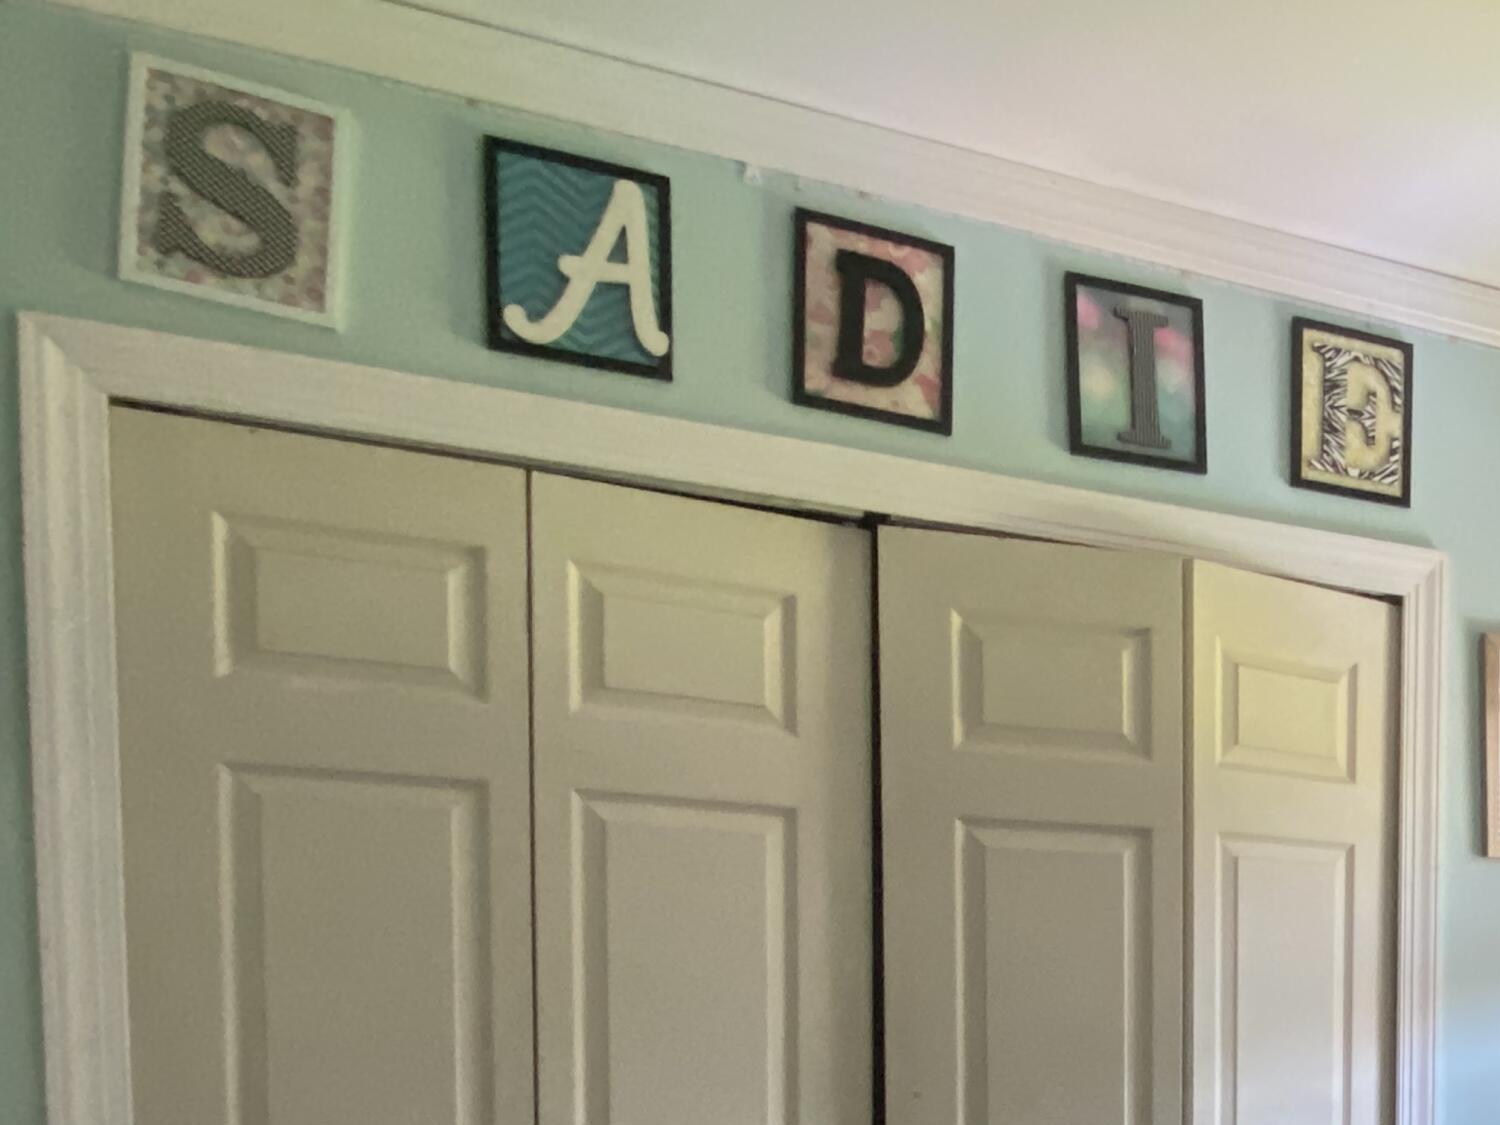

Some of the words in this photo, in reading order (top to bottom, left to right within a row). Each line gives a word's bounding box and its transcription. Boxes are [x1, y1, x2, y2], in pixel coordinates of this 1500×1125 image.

[161, 101, 298, 281] S
[502, 178, 670, 357] A
[833, 249, 926, 388] D
[1113, 306, 1172, 449] I
[1308, 342, 1403, 486] E
